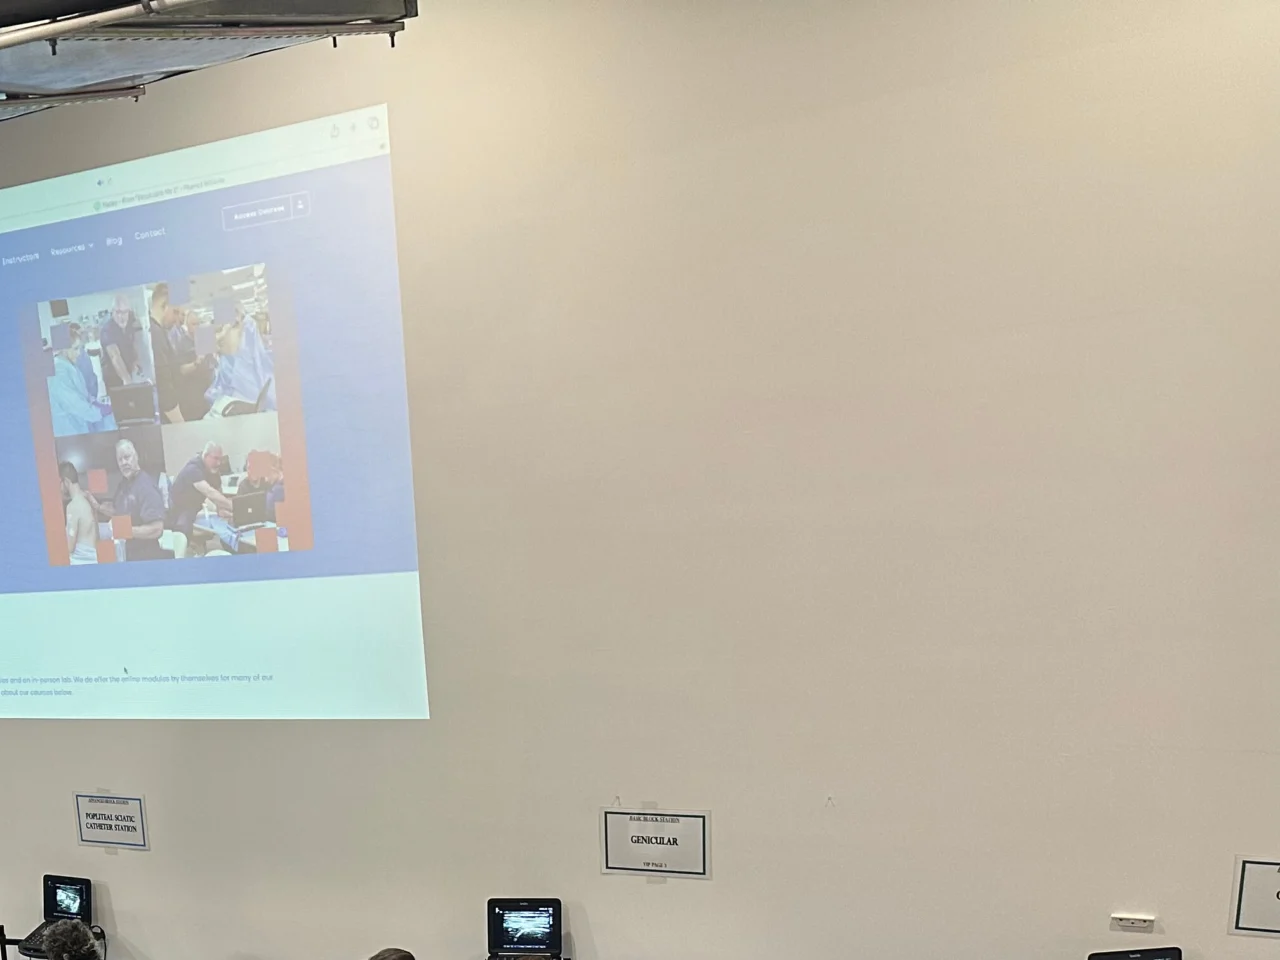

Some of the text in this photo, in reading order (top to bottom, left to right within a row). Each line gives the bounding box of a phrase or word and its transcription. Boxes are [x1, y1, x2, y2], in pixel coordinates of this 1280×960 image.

[135, 227, 166, 240] Contact
[106, 235, 123, 248] Blog
[51, 243, 86, 256] Resources
[2, 252, 40, 266] Instructors
[85, 812, 135, 823] POPLITEAL SCIATIC
[85, 822, 137, 832] CATHETER STATION
[630, 835, 679, 846] GENICULAR
